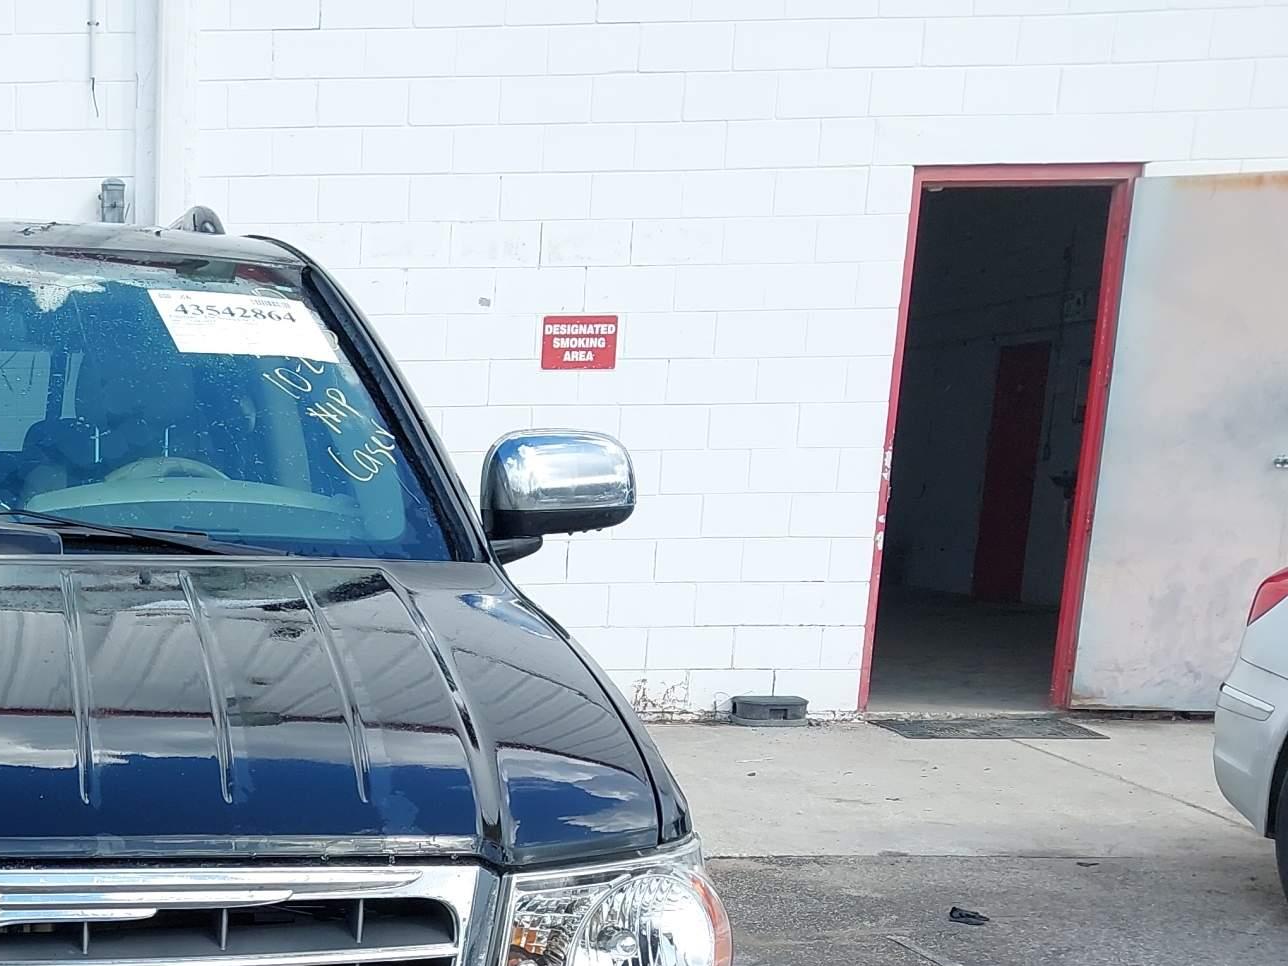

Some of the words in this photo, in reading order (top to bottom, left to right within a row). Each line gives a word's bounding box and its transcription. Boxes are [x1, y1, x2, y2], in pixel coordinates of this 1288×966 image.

[174, 303, 297, 323] 43542864
[544, 324, 616, 335] DESIGNATED
[552, 337, 606, 348] SMOKING
[563, 350, 594, 362] AREA
